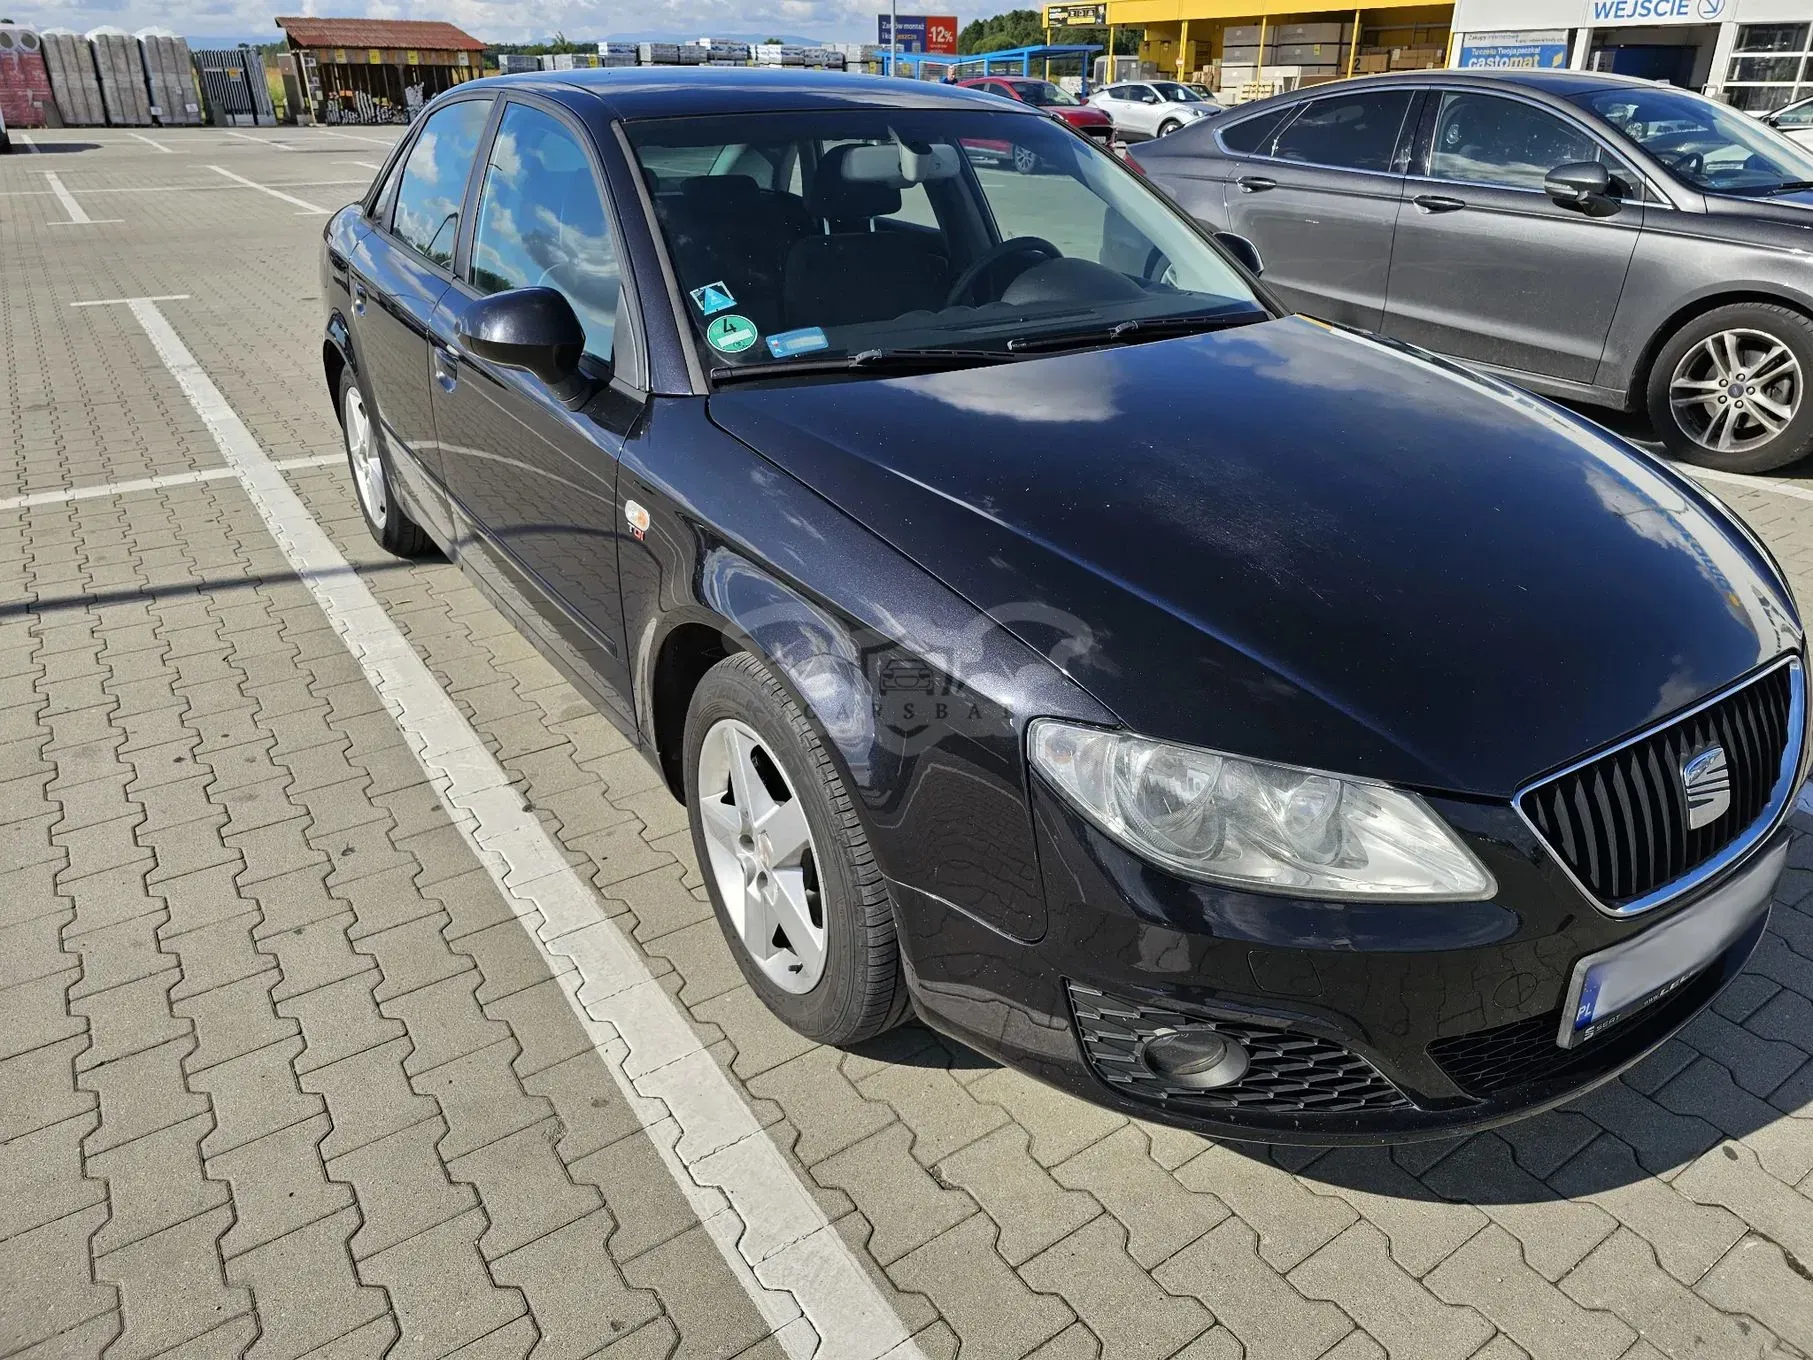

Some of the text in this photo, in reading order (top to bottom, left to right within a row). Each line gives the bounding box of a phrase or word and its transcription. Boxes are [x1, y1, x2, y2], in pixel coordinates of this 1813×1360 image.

[929, 26, 954, 43] -12%
[1498, 48, 1516, 56] Twoja
[1517, 47, 1541, 56] paczka!
[1468, 54, 1540, 68] castomat
[723, 318, 737, 333] 4
[1576, 1002, 1592, 1022] PL
[1596, 1013, 1621, 1031] SEAT
